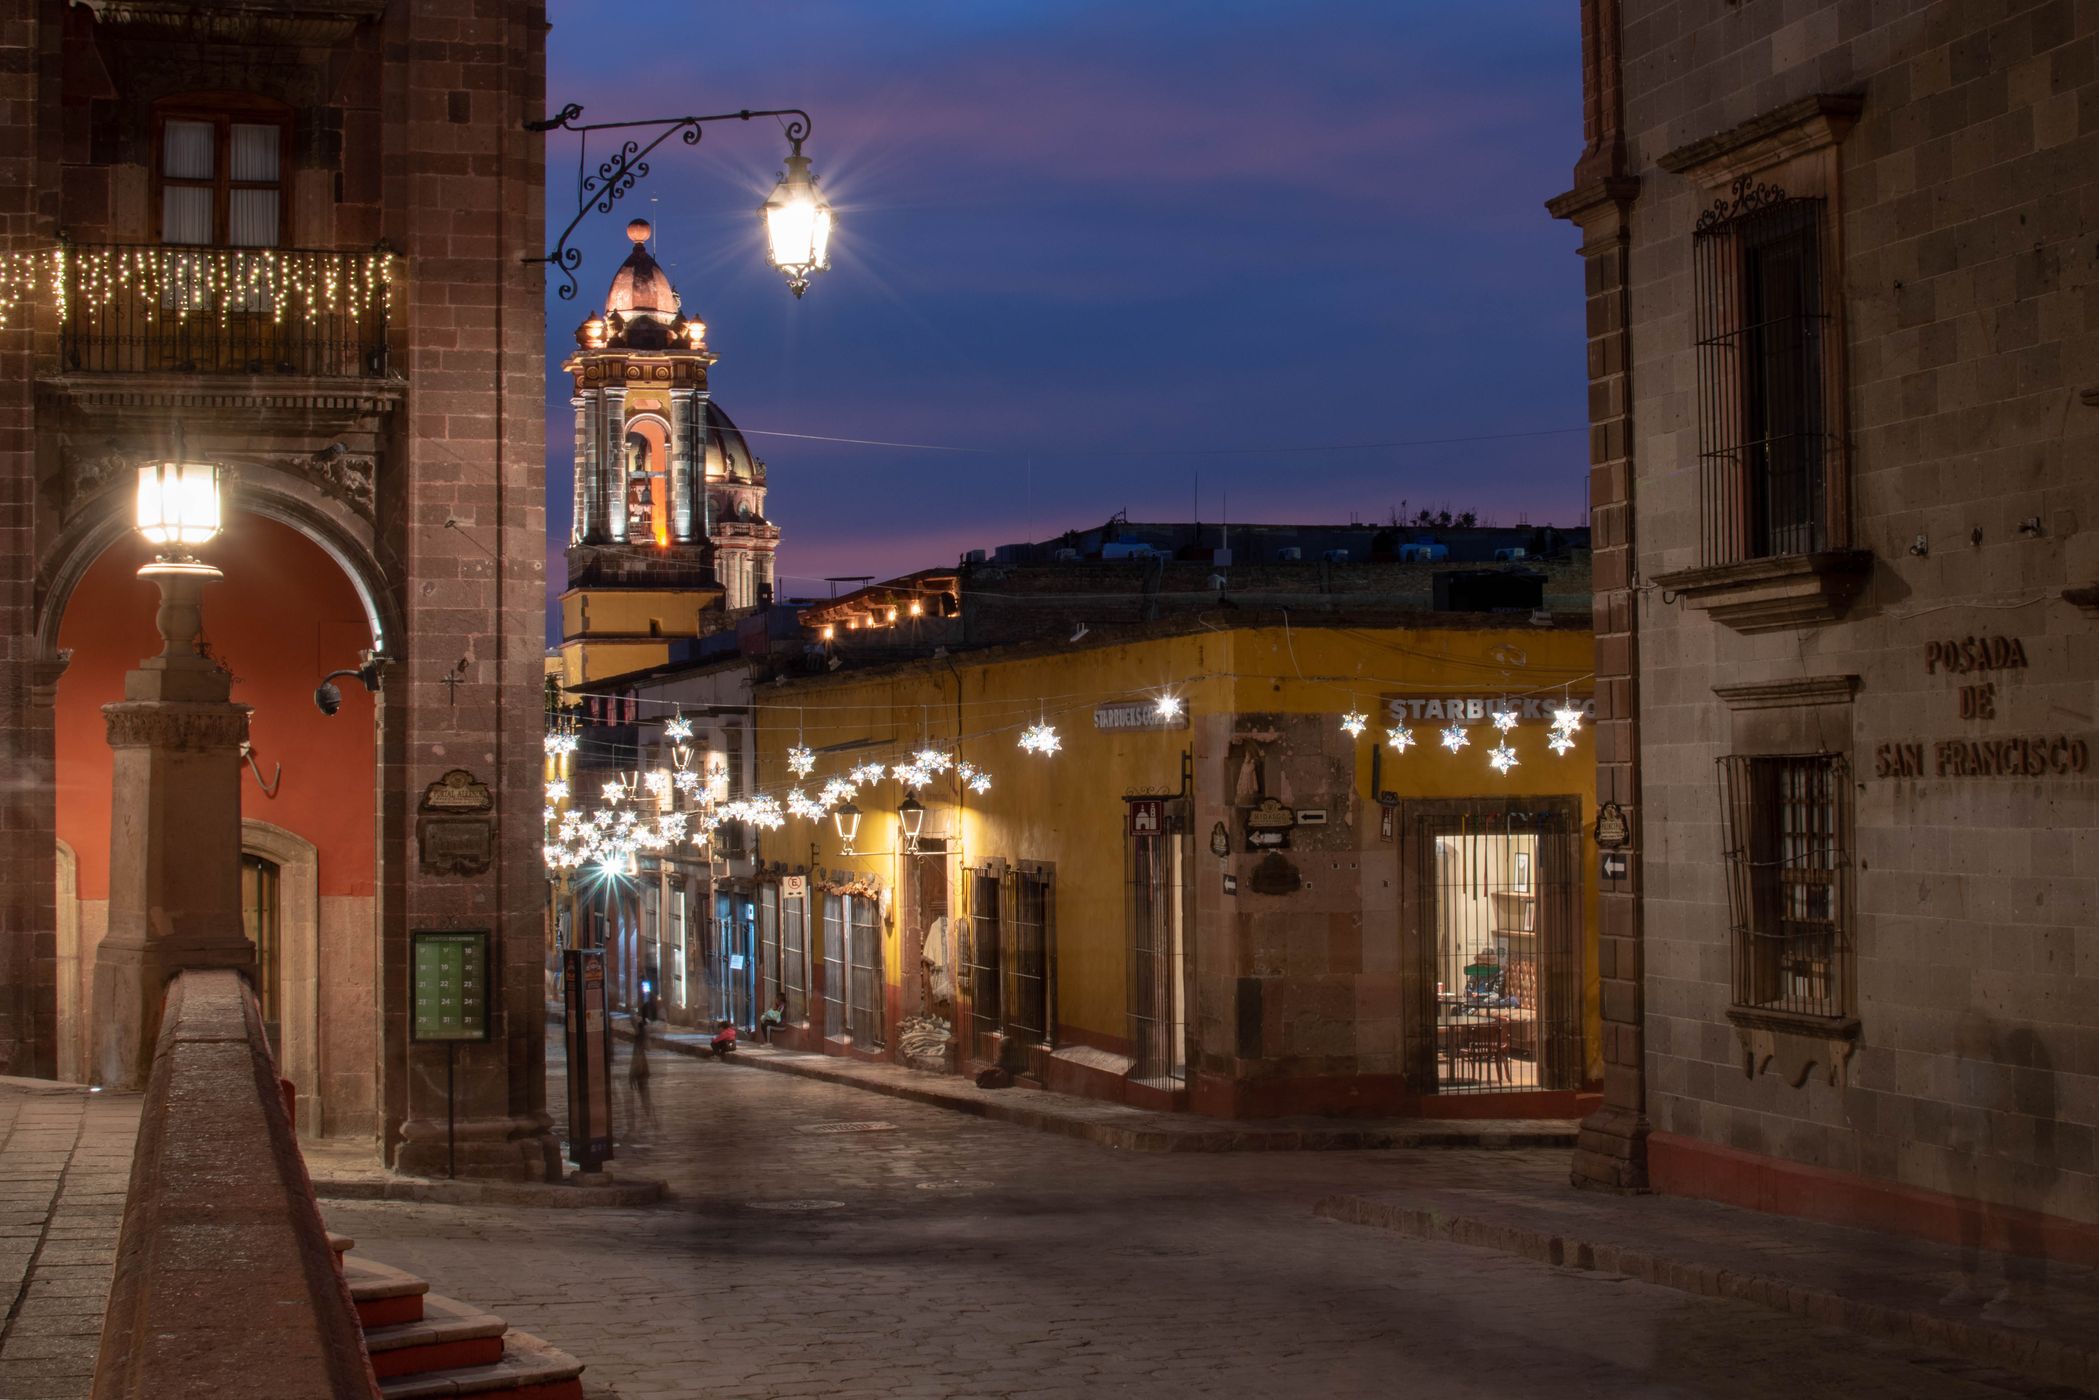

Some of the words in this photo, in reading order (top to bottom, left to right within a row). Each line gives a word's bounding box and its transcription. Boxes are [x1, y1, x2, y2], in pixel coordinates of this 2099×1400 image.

[1924, 635, 2029, 675] POSADA
[1094, 707, 1141, 728] STARBUCKS
[1389, 698, 1561, 720] STARBUCKS
[1958, 682, 1996, 720] DE
[1875, 742, 1924, 778] SAN
[1933, 735, 2089, 778] FRANCISCO
